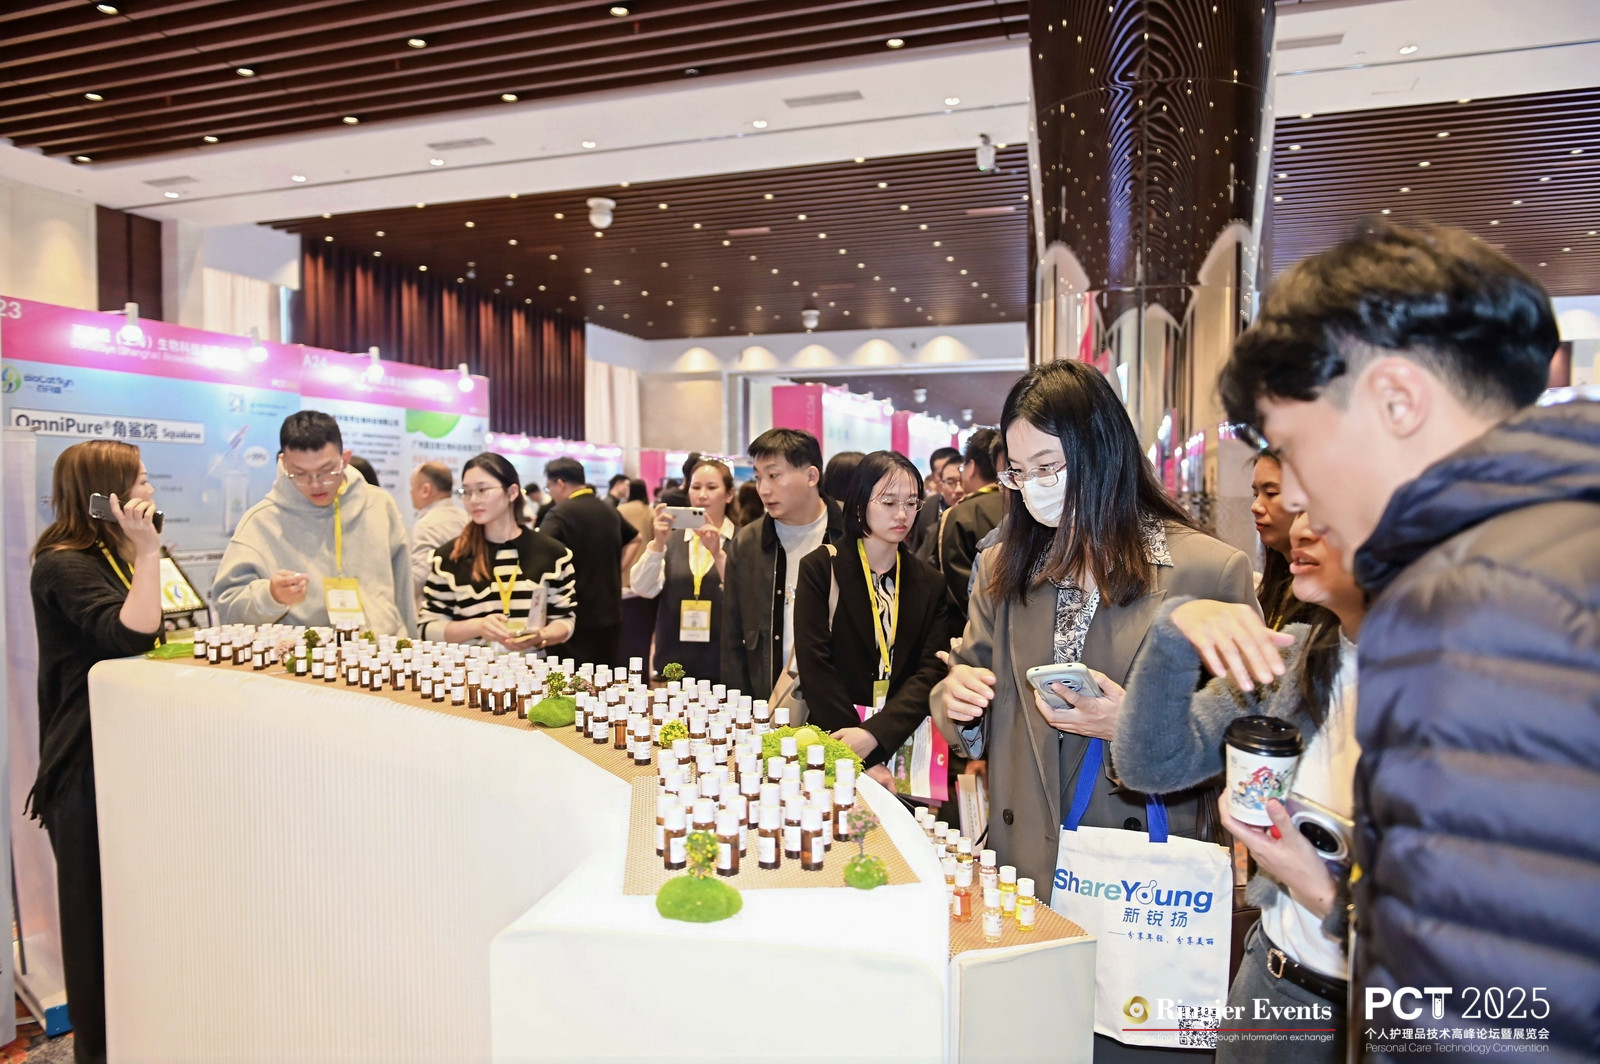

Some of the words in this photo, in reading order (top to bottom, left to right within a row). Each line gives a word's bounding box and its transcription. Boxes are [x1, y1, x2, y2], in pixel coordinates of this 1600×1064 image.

[302, 353, 328, 370] A24
[1054, 868, 1213, 913] ShareYoung
[1122, 907, 1188, 928] 新锐扬
